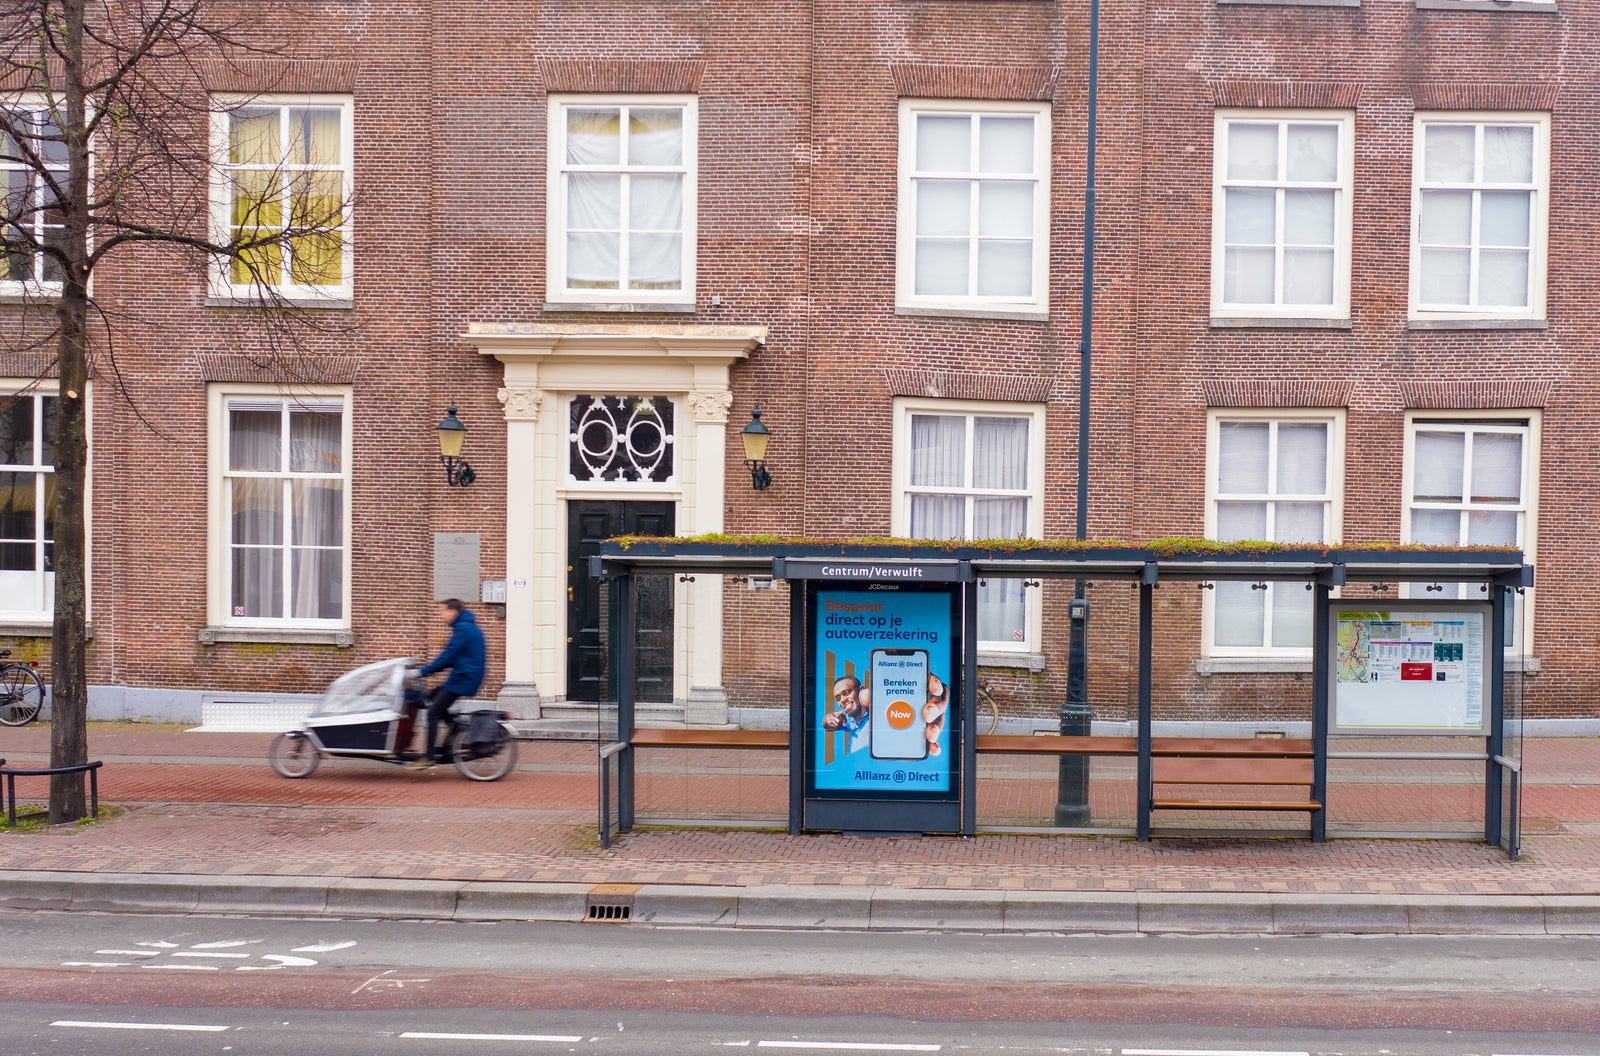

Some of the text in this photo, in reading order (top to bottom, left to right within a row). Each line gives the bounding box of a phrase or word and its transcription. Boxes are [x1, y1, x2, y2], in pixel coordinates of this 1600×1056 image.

[821, 566, 923, 578] Centrum/Verwulft
[825, 599, 884, 614] Bespaar
[825, 613, 902, 628] direct op je
[825, 627, 938, 643] autoverzekering
[883, 678, 918, 687] Bereken
[886, 687, 915, 697] premie
[890, 709, 911, 719] Now
[854, 770, 940, 782] Allianz Direct
